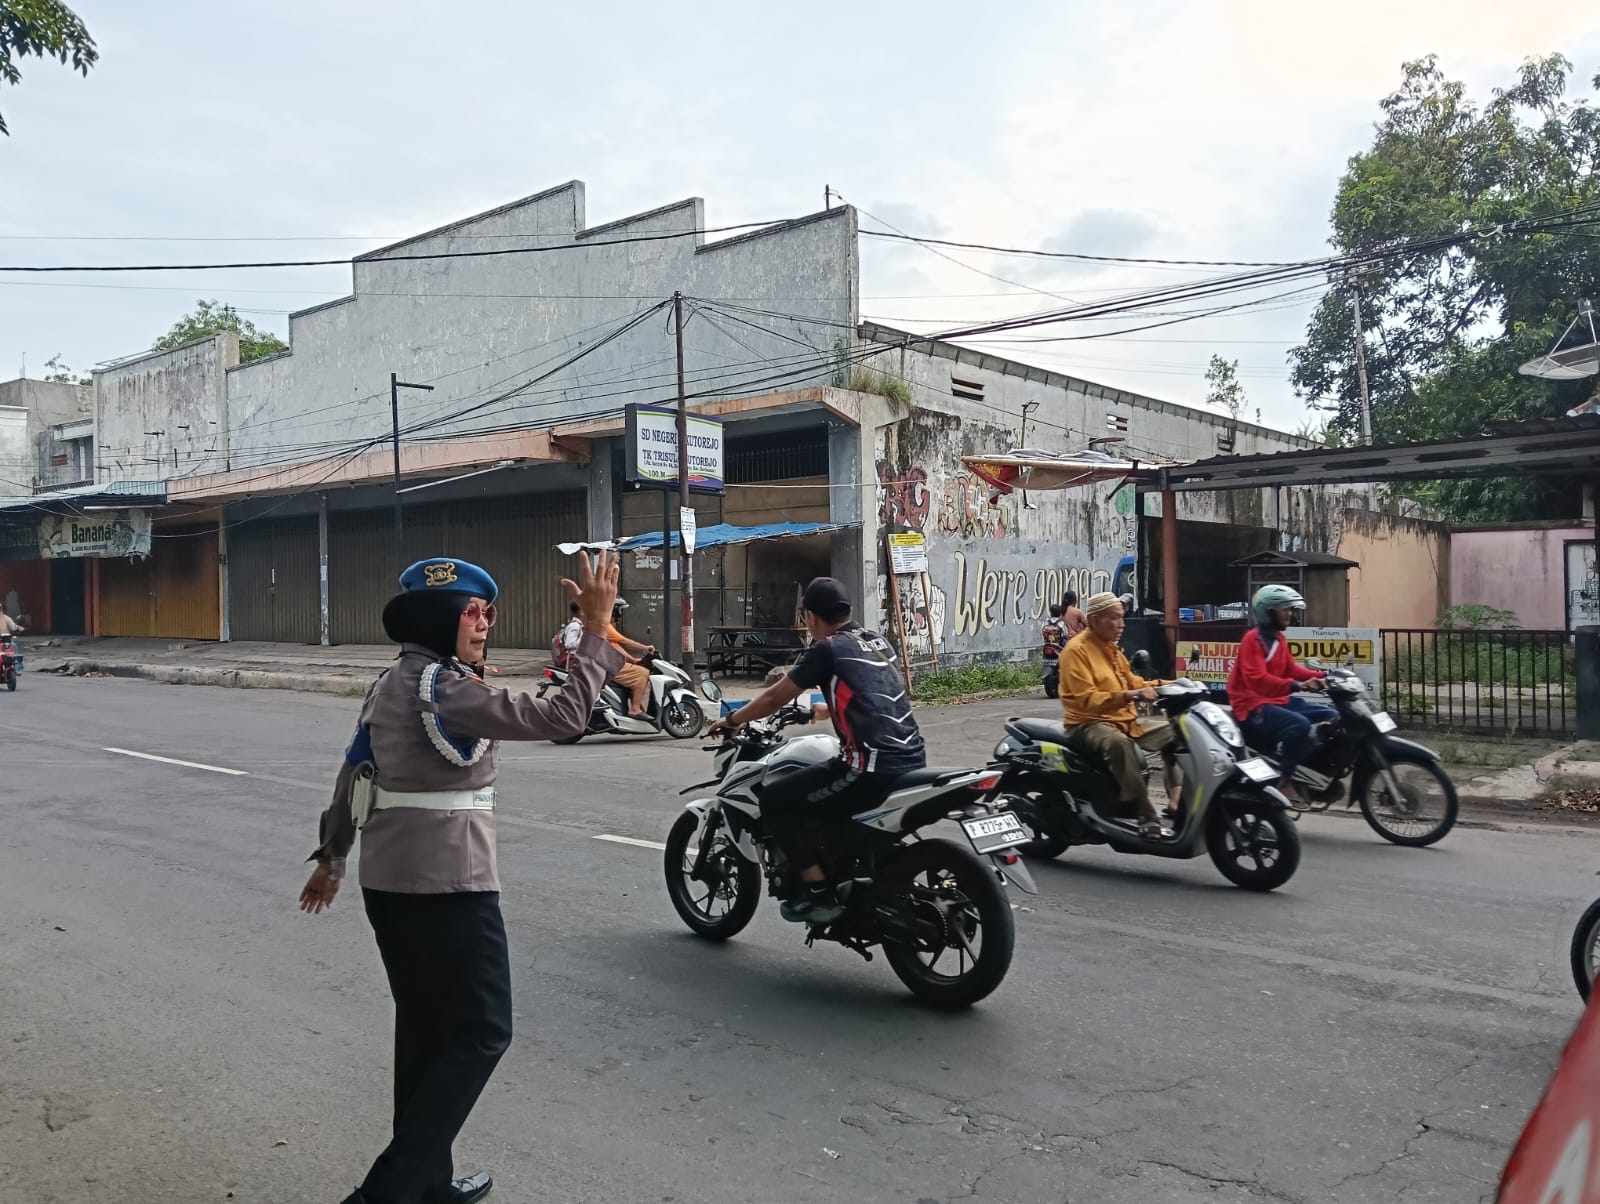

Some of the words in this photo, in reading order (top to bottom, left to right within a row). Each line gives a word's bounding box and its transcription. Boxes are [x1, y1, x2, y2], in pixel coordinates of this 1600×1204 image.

[641, 428, 651, 440] SD
[652, 429, 677, 444] NEGERI
[642, 449, 652, 460] TK
[653, 451, 679, 463] TRISUL
[71, 523, 112, 543] Banana
[1287, 641, 1367, 659] DIJUAL
